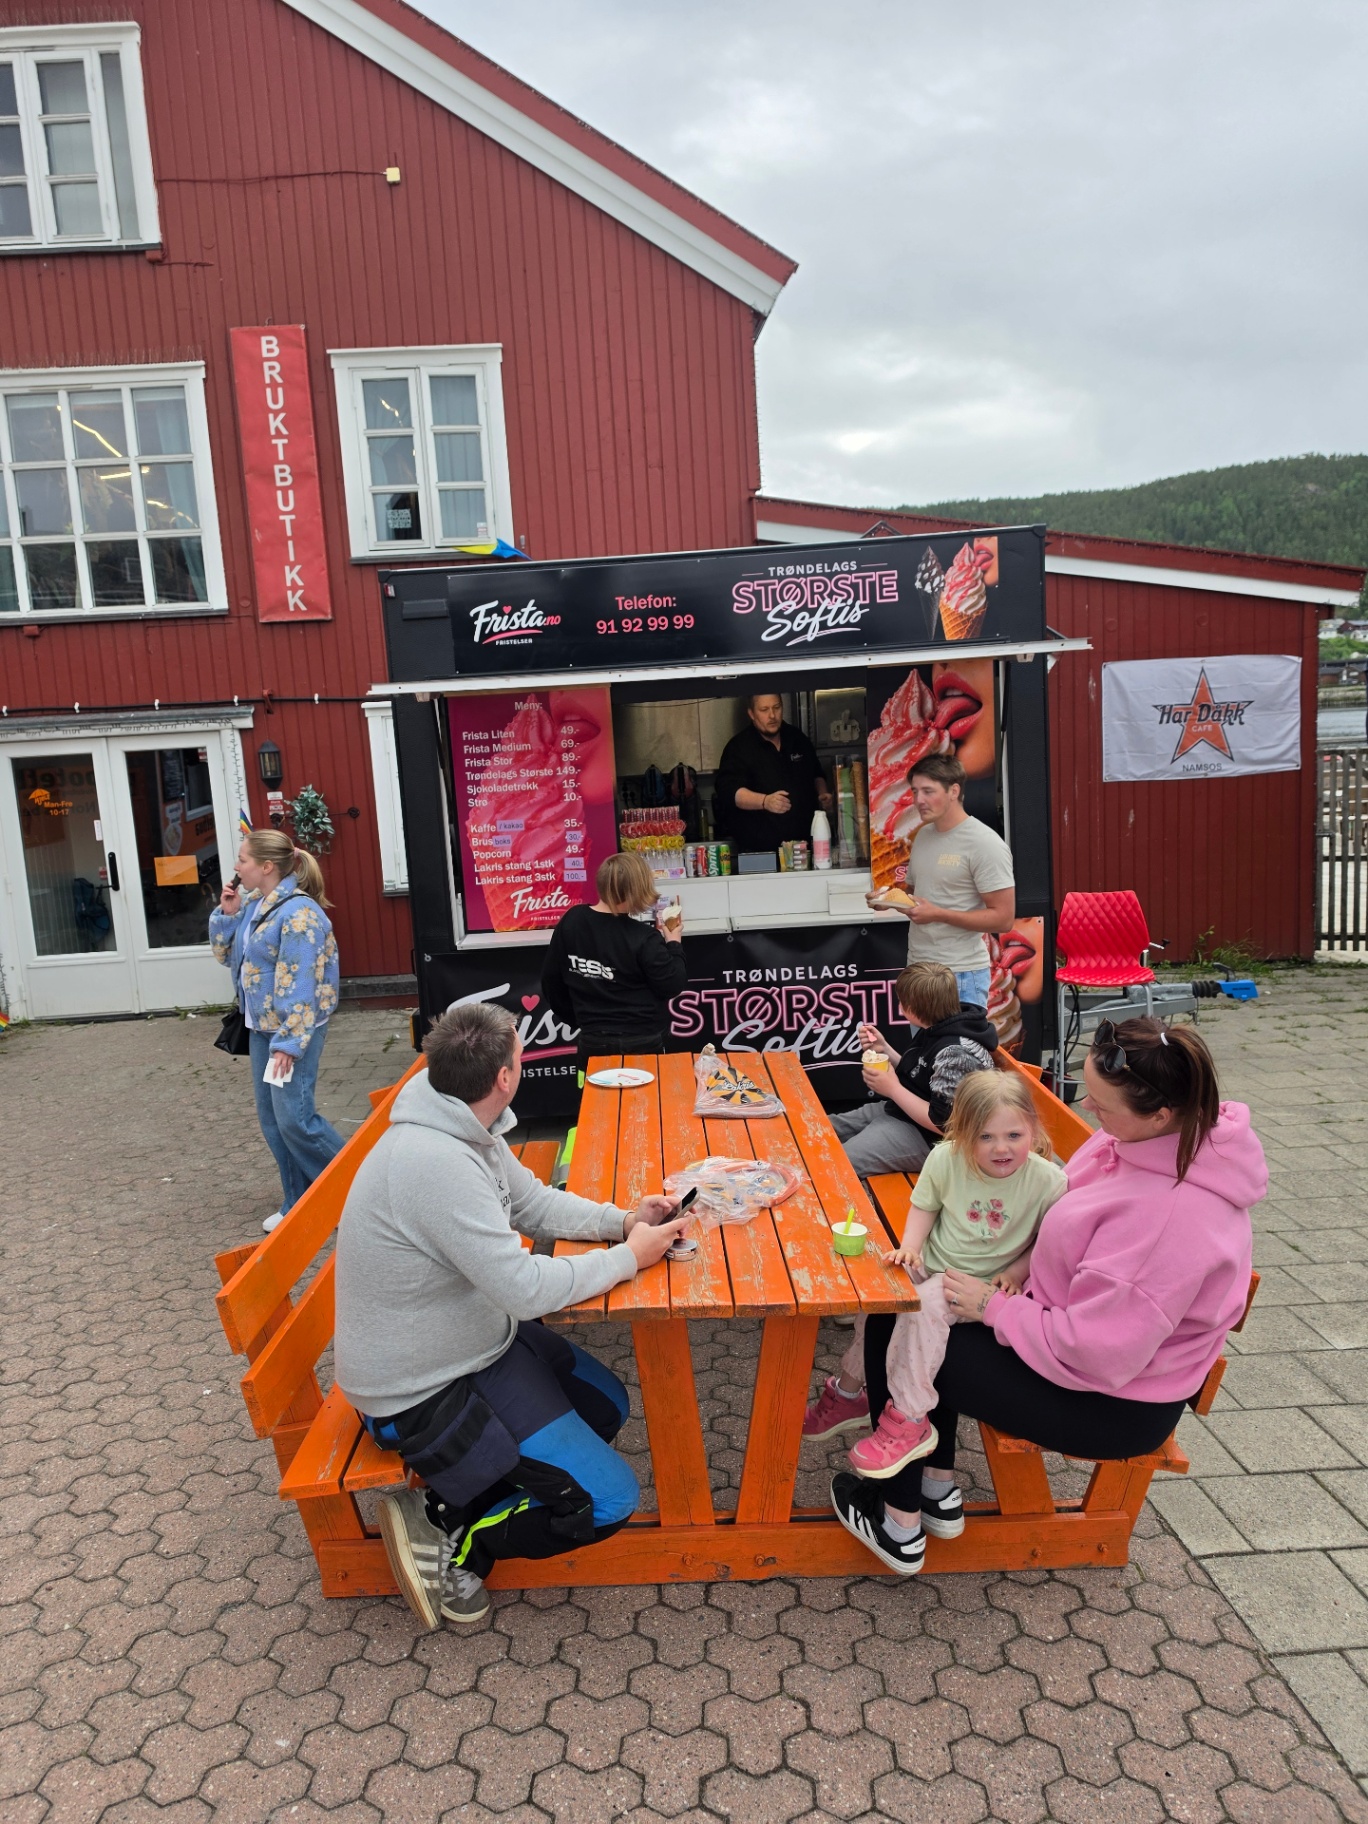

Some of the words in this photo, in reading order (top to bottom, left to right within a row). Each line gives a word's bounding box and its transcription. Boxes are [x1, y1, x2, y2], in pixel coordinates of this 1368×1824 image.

[260, 335, 308, 612] BRUKTBUTIKK
[768, 560, 858, 577] TRØNDELAGS
[732, 569, 899, 614] STØRSTE
[615, 594, 677, 611] Telefon:
[596, 618, 618, 634] 91
[622, 617, 643, 633] 92
[648, 615, 669, 631] 99
[673, 613, 695, 629] 99
[761, 597, 870, 643] Softis
[495, 637, 533, 646] FRISTELSER
[514, 701, 543, 711] Meny:
[1158, 704, 1192, 725] Har
[462, 731, 489, 741] Frista
[491, 729, 515, 739] Liten
[560, 725, 580, 735] 49.-
[463, 744, 490, 754] Frista
[492, 742, 531, 752] Medium
[560, 738, 580, 748] 69.-
[464, 757, 491, 767] Frista
[493, 756, 513, 766] Stor
[561, 751, 581, 762] 89.-
[1182, 762, 1223, 772] NAMSOS
[465, 770, 518, 781] Trøndelags
[519, 767, 553, 778] Største
[556, 765, 581, 775] 149.-
[466, 782, 539, 795] Sjokoladetrekk
[562, 778, 581, 788] 15.-
[467, 798, 489, 807] Strø
[563, 791, 582, 802] 10.-
[470, 824, 497, 833] Kaffe
[564, 818, 583, 828] 35.-
[472, 837, 493, 846] Brus
[494, 837, 511, 846] boks
[473, 850, 512, 859] Popcorn
[565, 844, 584, 854] 49.-
[474, 862, 503, 873] Lakris
[505, 860, 532, 871] stang
[534, 859, 555, 869] 1stk
[708, 845, 719, 876] Sprite
[475, 875, 504, 885] Lakris
[506, 873, 533, 884] stang
[534, 872, 556, 882] 3stk
[568, 954, 614, 980] TESS
[723, 964, 858, 984] TRØNDELAGS
[522, 1065, 577, 1078] ISTELSE
